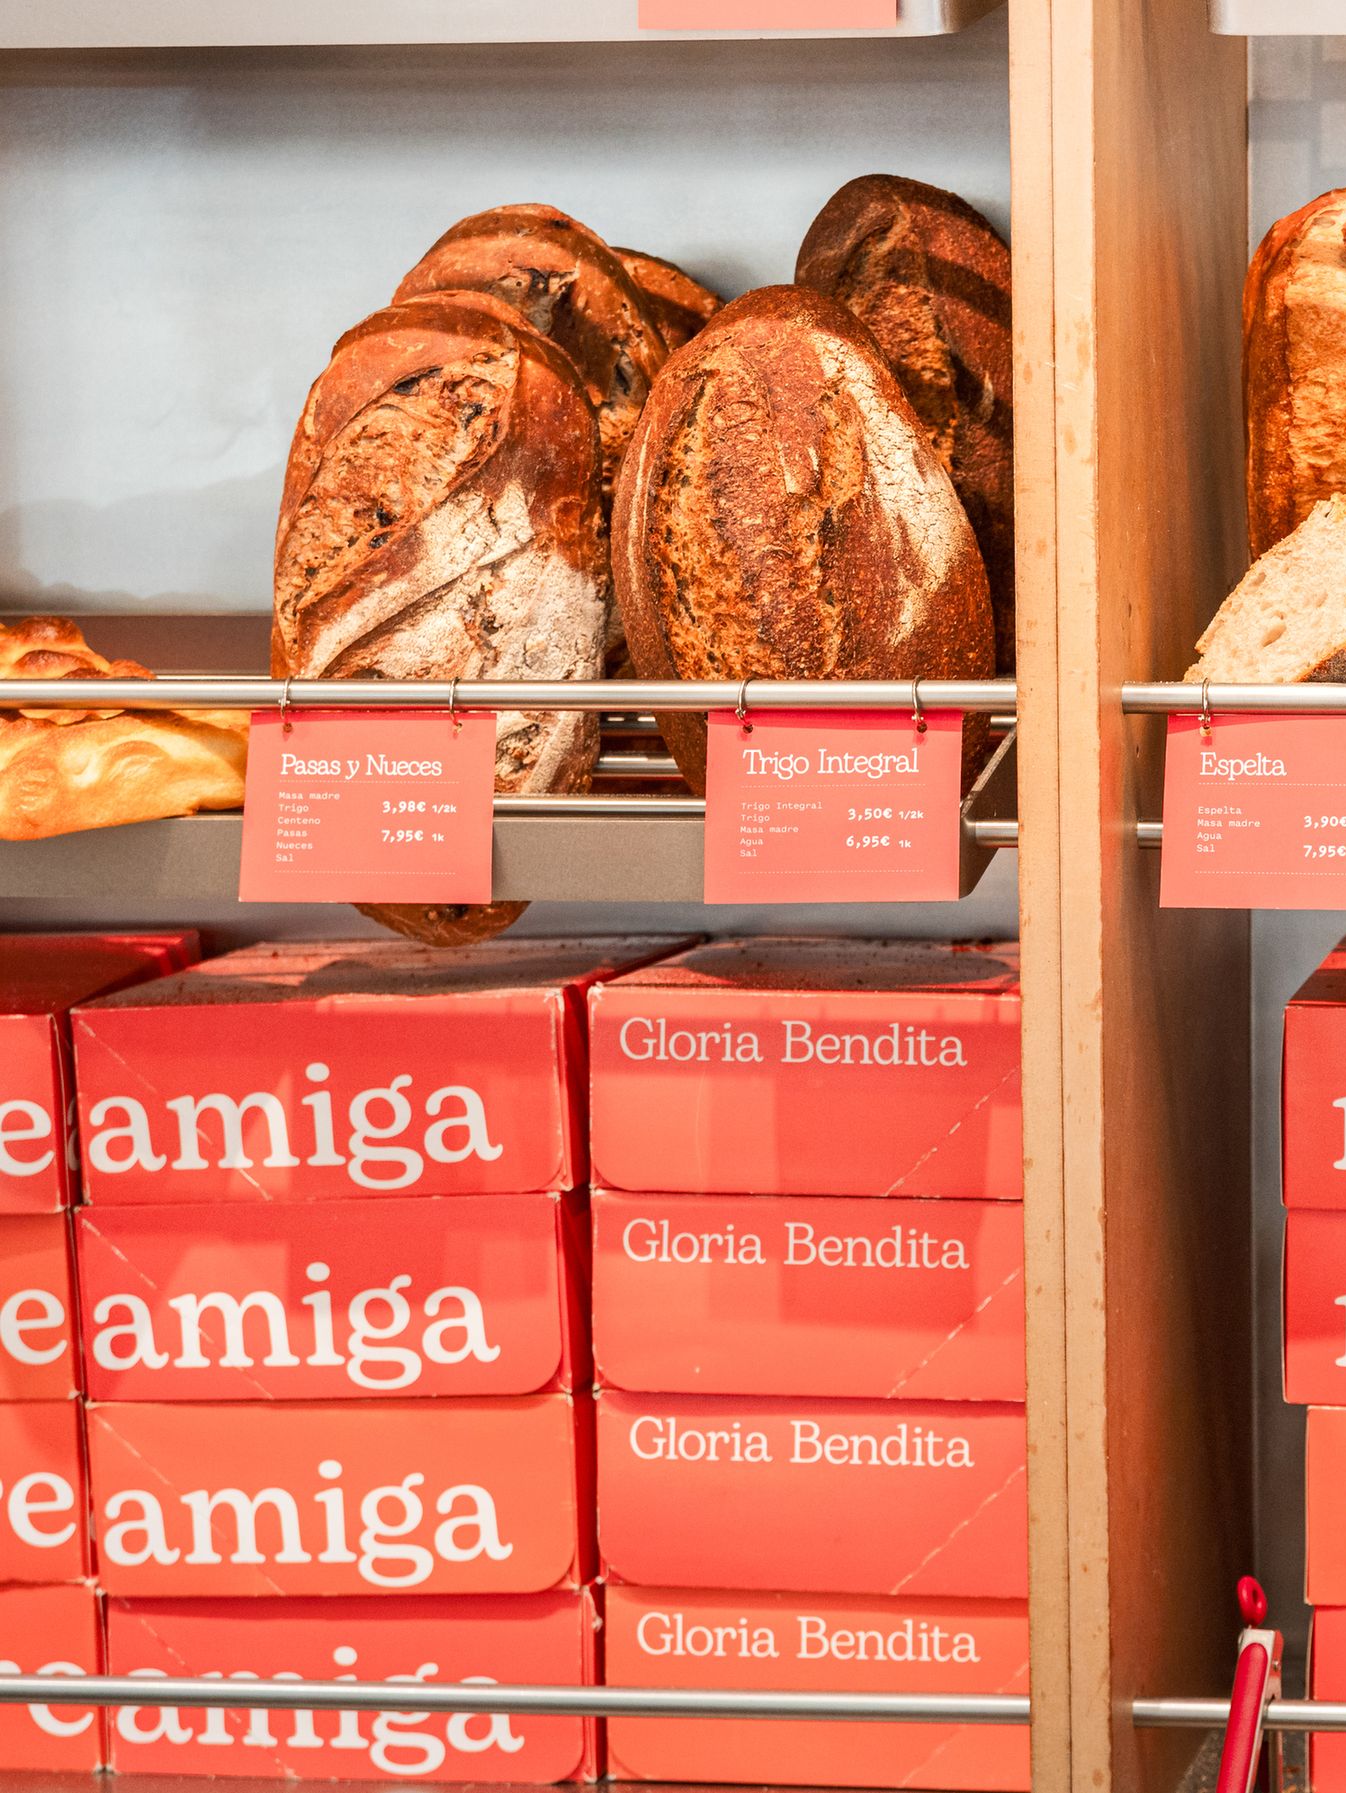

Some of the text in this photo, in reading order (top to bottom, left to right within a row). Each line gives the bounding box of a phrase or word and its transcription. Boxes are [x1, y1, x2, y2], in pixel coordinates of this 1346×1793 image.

[280, 753, 442, 780] Pasas y Nueces
[742, 748, 919, 780] Trigo Integral
[1199, 752, 1287, 780] Espelta
[278, 792, 340, 800] Masa madre
[279, 804, 309, 814] Trigo
[382, 801, 457, 814] 3,98€ 1/2k
[741, 801, 822, 811] Trigo Integral
[1198, 806, 1242, 816] Espelta
[277, 817, 321, 825] Centeno
[740, 814, 770, 823] Trigo
[847, 808, 924, 821] 3,50€ 1/2k
[769, 825, 799, 833] madre
[1197, 819, 1261, 827] Masa madre
[276, 829, 308, 837] Pasas
[381, 830, 444, 843] 7,95€ 1k
[1196, 832, 1222, 841] Agua
[739, 838, 763, 847] Agua
[846, 836, 911, 849] 6,95€ 1k
[1196, 844, 1215, 852] Sal
[275, 854, 294, 862] Sal
[739, 849, 757, 857] Sal
[1303, 845, 1346, 859] 7,95€
[619, 1017, 967, 1066] Gloria Bendita
[88, 1063, 503, 1189] amiga
[622, 1219, 969, 1268] Gloria Bendita
[93, 1263, 500, 1389] amiga
[629, 1416, 974, 1467] Gloria Bendita
[104, 1460, 513, 1587] amiga
[636, 1612, 980, 1662] Gloria Bendita
